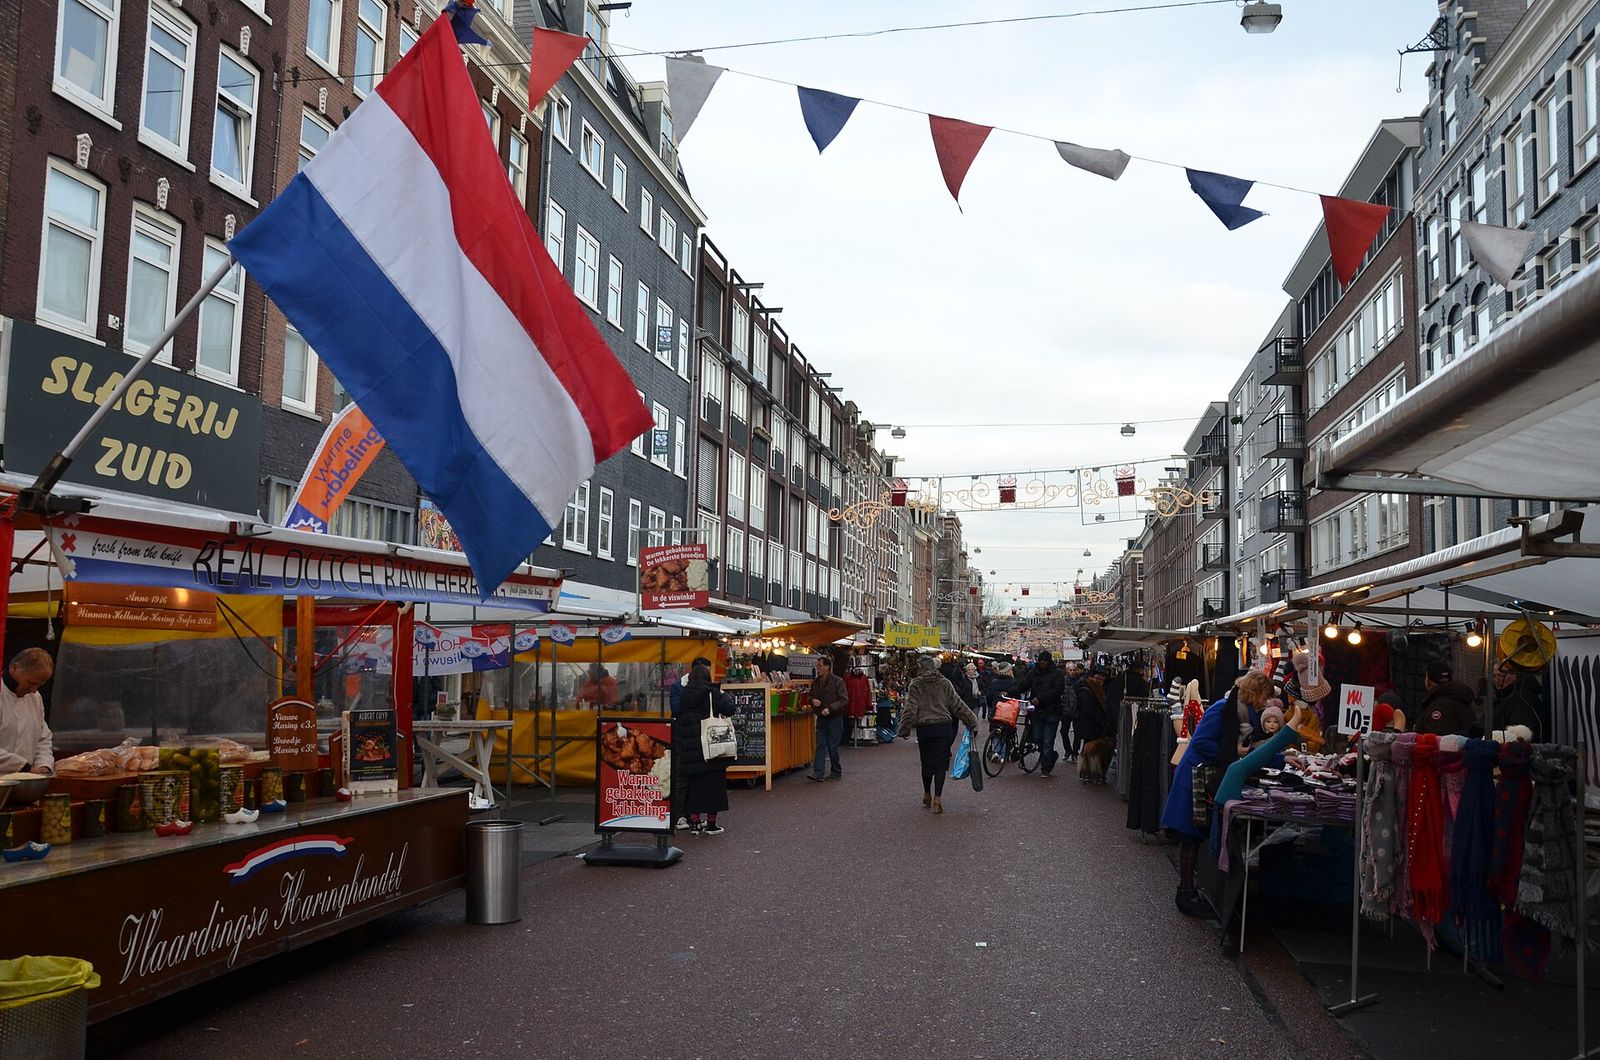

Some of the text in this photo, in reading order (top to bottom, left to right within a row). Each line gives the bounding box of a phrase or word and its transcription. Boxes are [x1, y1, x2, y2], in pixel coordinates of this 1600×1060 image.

[42, 356, 238, 439] SLAGERIJ
[95, 437, 192, 489] ZUID
[92, 538, 183, 566] fresh from the knife
[645, 549, 664, 560] Warme
[665, 545, 692, 556] gebakken
[655, 553, 680, 564] lekkerste
[192, 539, 272, 588] REAL
[282, 549, 377, 594] DUTCH
[384, 558, 429, 597] RAW
[125, 591, 149, 602] Anno
[659, 594, 667, 602] de
[668, 592, 696, 601] viswinkel
[76, 607, 111, 619] Winnaar
[112, 610, 149, 621] Hollandse
[149, 613, 175, 625] Haring
[895, 636, 911, 645] BEL
[272, 721, 298, 730] Haring
[273, 736, 301, 746] Broodje
[273, 746, 299, 755] Haring
[617, 770, 659, 786] Warme
[605, 784, 662, 804] gebakken
[612, 801, 667, 821] kibbeling
[118, 842, 409, 984] Vlaardingse Haringhandel
